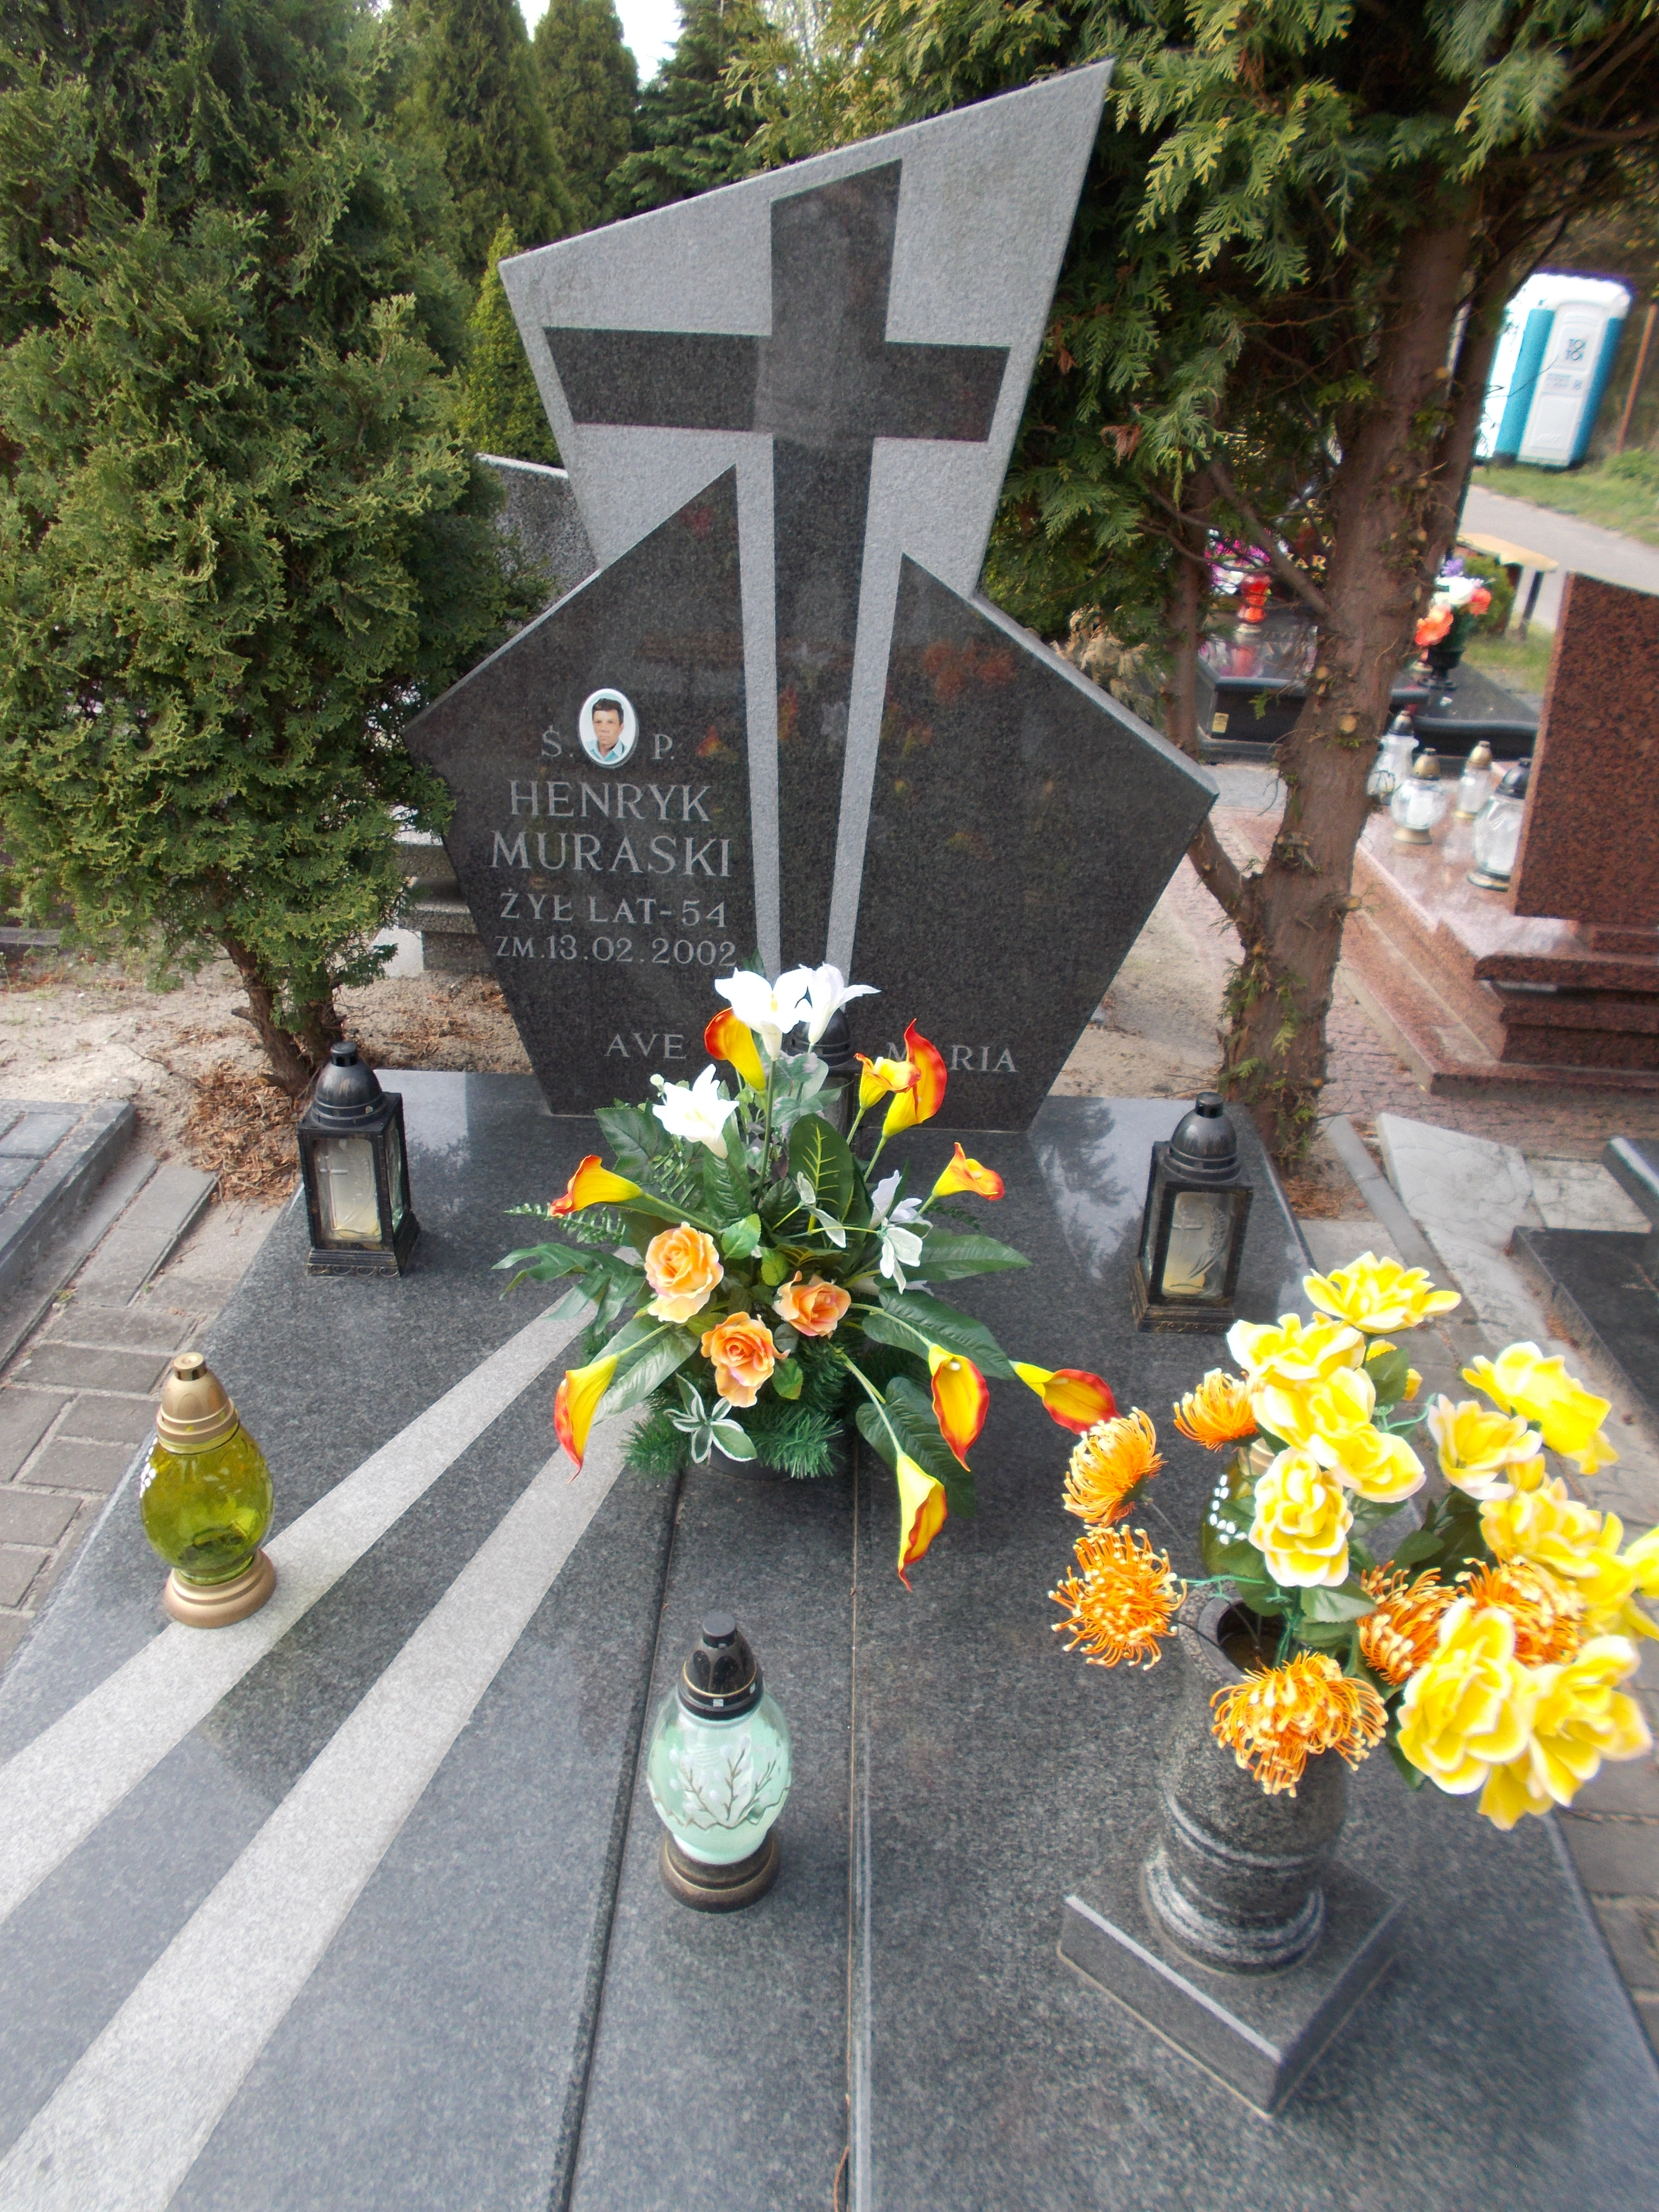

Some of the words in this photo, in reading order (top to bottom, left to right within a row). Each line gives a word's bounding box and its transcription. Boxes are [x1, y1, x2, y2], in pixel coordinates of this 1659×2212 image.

[509, 780, 711, 822] HENRYK
[491, 831, 732, 877] MURASKI
[500, 888, 574, 921] ŻYŁ
[603, 1033, 686, 1059] AVE
[888, 1042, 1019, 1072] MRIA
